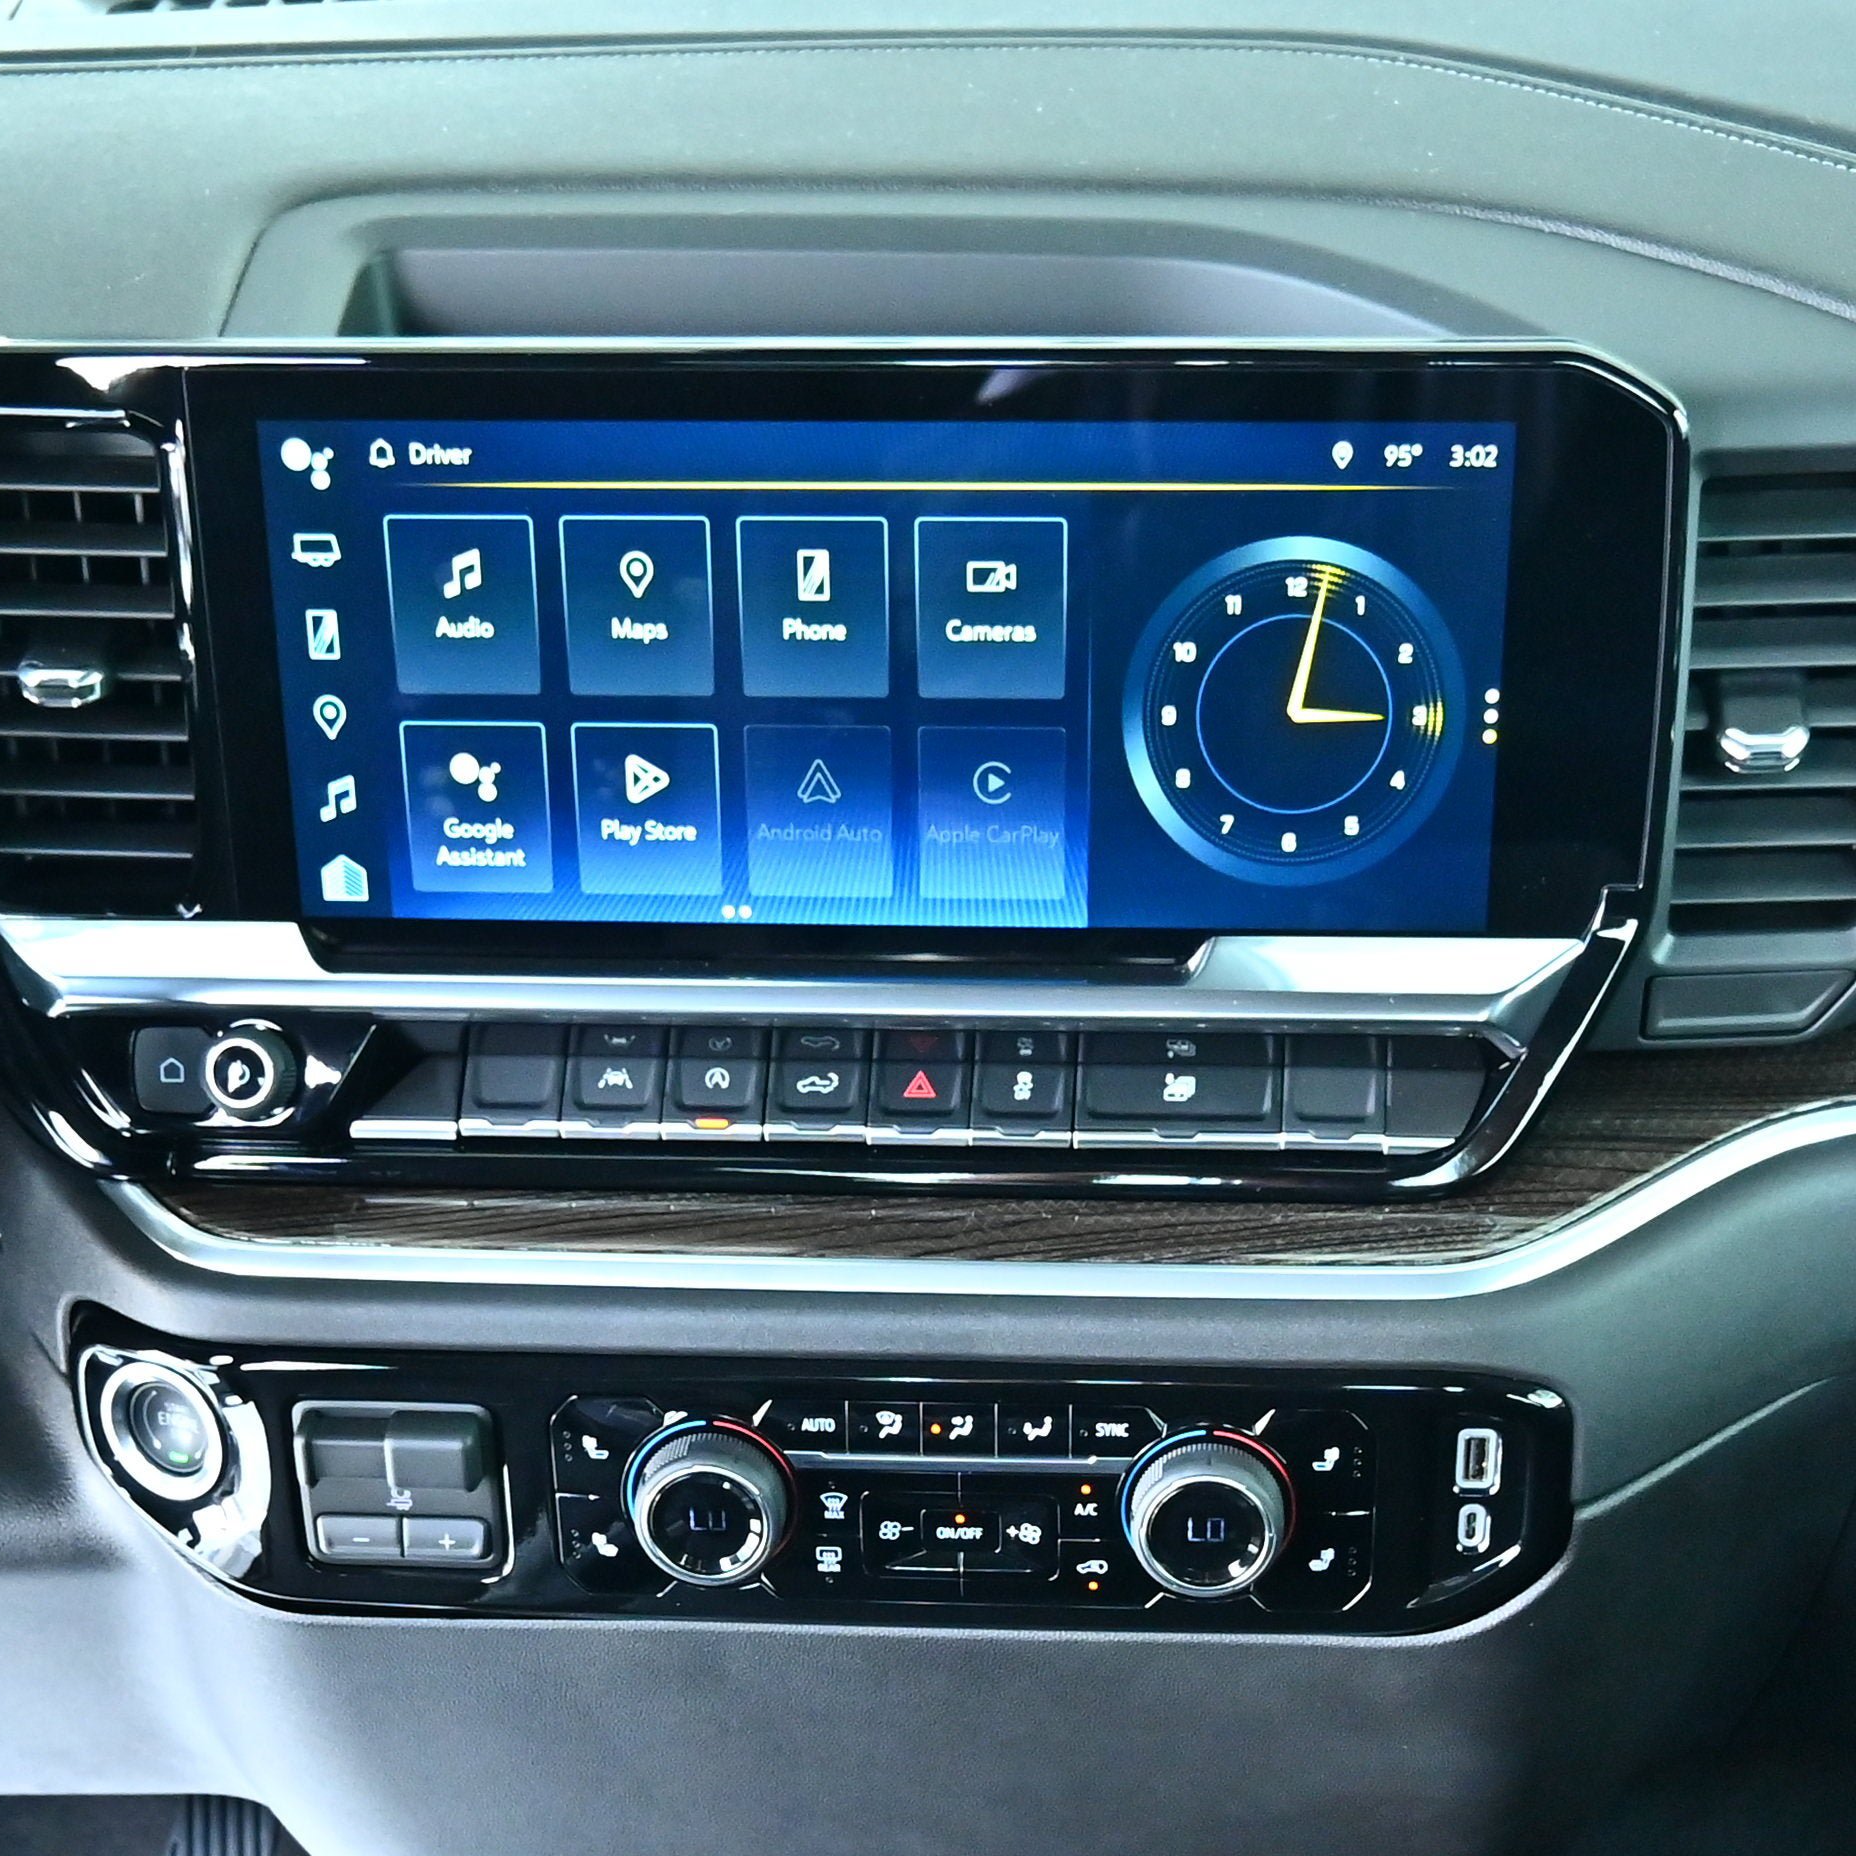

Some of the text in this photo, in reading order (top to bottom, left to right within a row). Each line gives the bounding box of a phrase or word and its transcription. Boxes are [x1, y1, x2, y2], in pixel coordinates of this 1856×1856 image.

[408, 442, 472, 466] Driver
[1383, 443, 1423, 468] 95°
[1448, 443, 1498, 468] 3:02
[1285, 576, 1309, 598] 12
[1225, 595, 1242, 616] 11
[1355, 594, 1366, 616] 1
[435, 616, 495, 640] Audio
[611, 617, 669, 645] Maps
[782, 617, 847, 642] Phone
[944, 618, 1037, 643] Cameras
[1172, 641, 1197, 663] 10
[1397, 642, 1414, 664] 2
[1160, 704, 1177, 726] 9
[1412, 704, 1428, 727] 3
[1175, 768, 1192, 789] 8
[1389, 769, 1406, 790] 4
[443, 817, 515, 845] Google
[601, 818, 697, 846] Play Store
[757, 823, 883, 842] Android Auto
[1219, 814, 1235, 835] 7
[1344, 815, 1360, 837] 5
[926, 824, 1061, 848] Apple CarPlay
[1281, 832, 1297, 853] 6
[435, 845, 527, 868] Assistant
[800, 1417, 836, 1432] AUTO
[1095, 1422, 1130, 1439] SYNC
[1074, 1502, 1098, 1518] A/C
[935, 1526, 984, 1541] ON/OFF
[1187, 1517, 1226, 1543] LO
